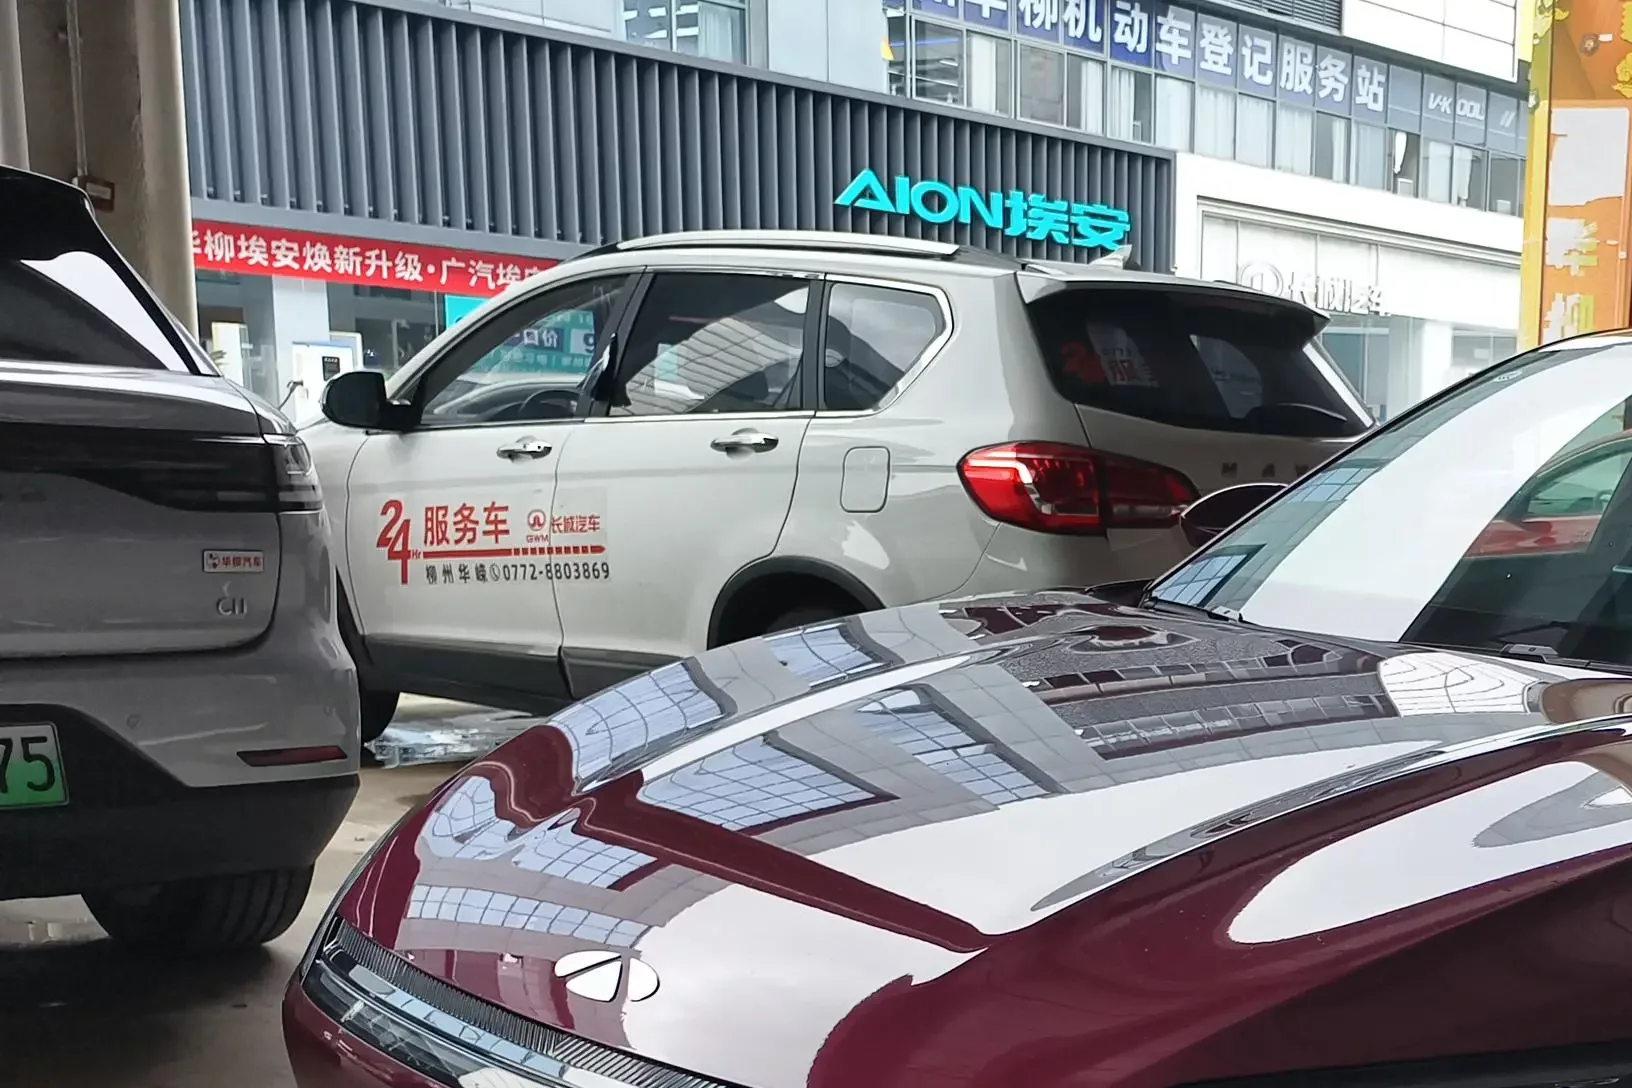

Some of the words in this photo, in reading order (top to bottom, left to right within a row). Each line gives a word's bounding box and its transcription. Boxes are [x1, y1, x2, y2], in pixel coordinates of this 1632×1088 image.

[932, 0, 1386, 112] 柳机动车登记服务站
[834, 167, 1131, 250] AION埃安
[423, 501, 510, 546] 服务车
[502, 561, 609, 582] 0772-8803869
